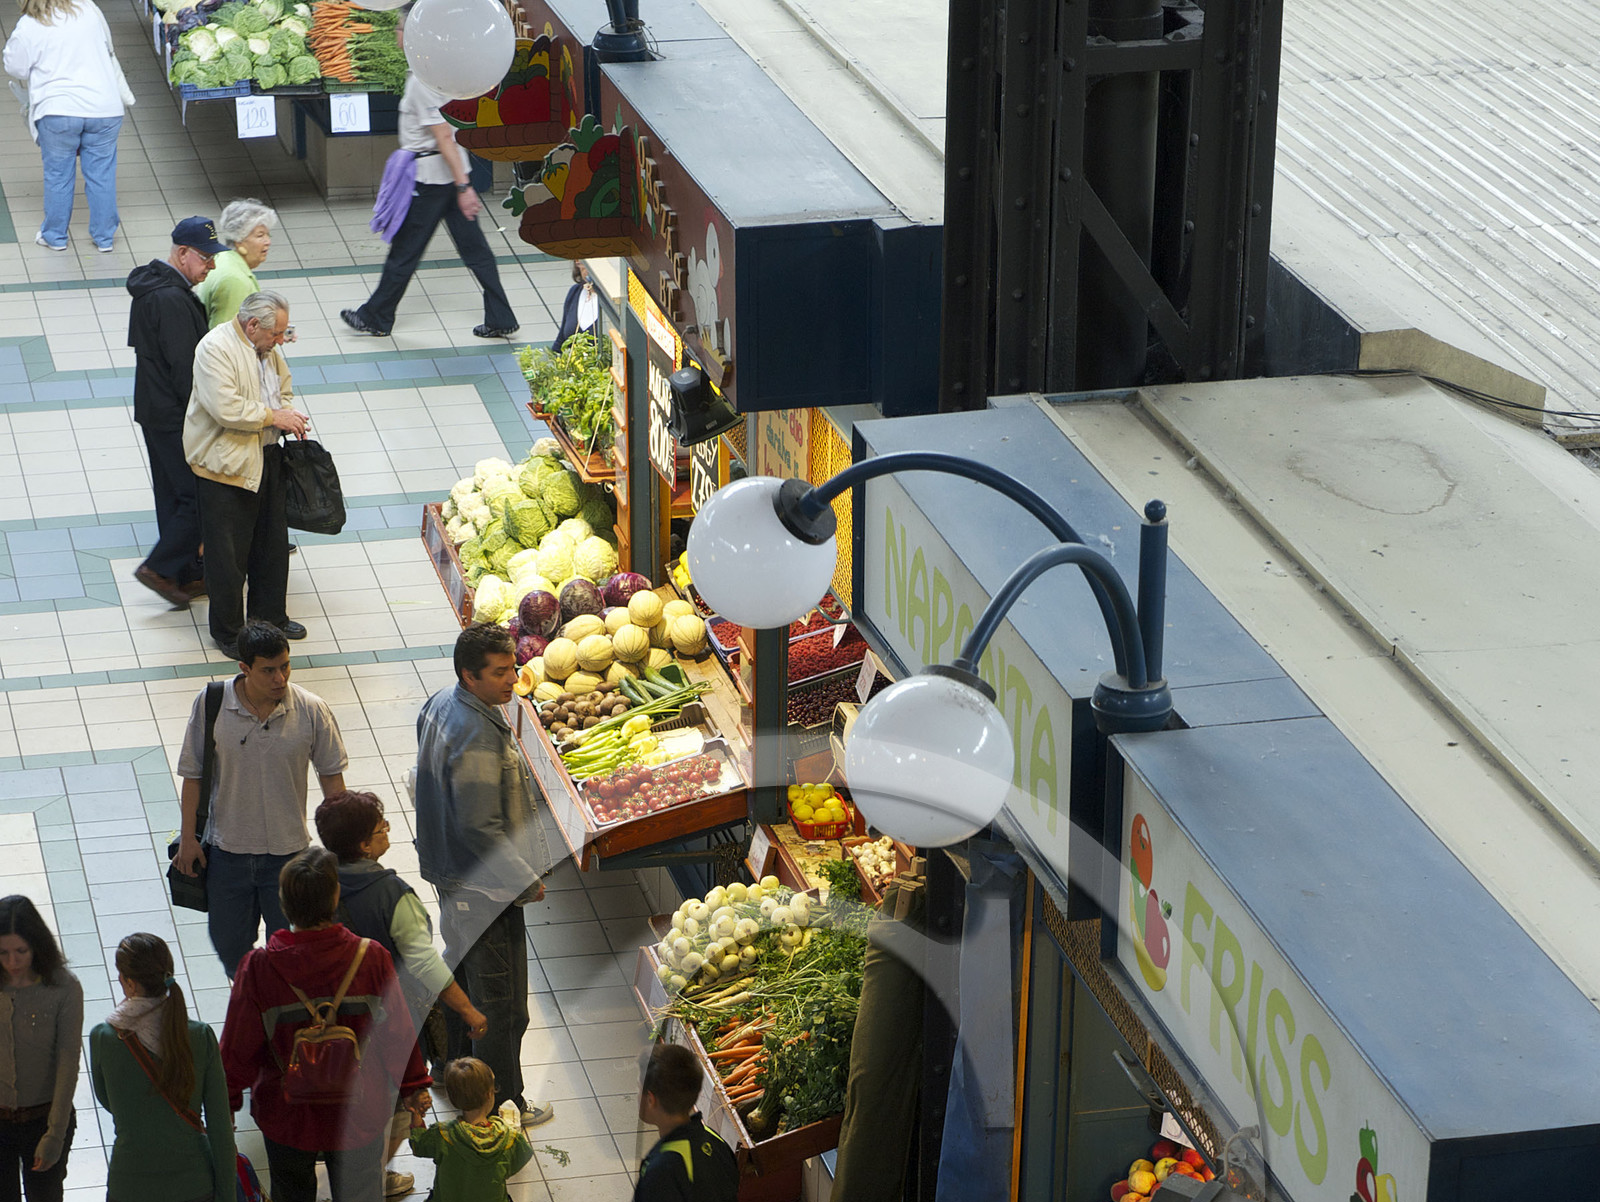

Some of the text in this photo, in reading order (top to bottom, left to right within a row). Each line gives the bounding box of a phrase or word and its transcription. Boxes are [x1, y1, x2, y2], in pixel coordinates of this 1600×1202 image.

[242, 106, 269, 130] 128
[338, 102, 357, 127] 60
[649, 360, 673, 418] MÁLN
[650, 399, 669, 472] 800
[1180, 880, 1331, 1185] FRISS
